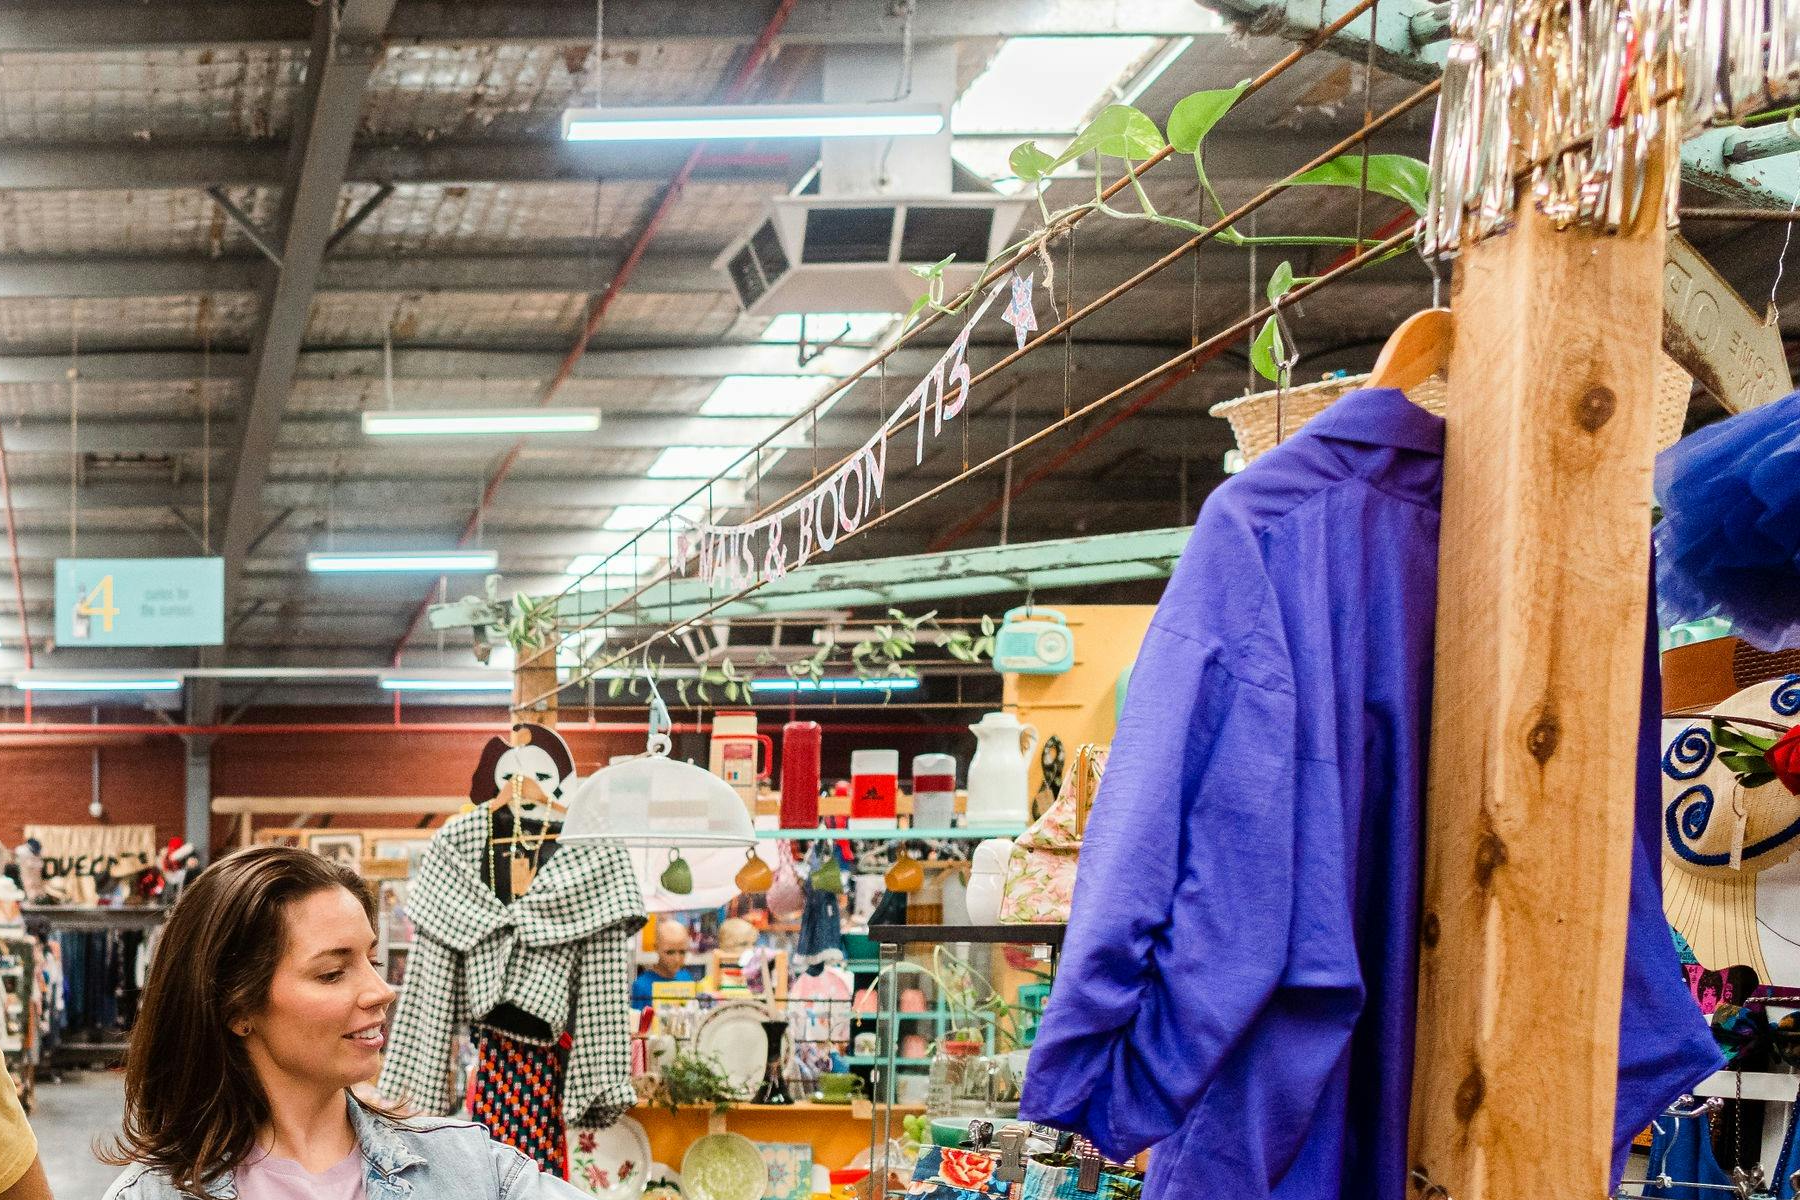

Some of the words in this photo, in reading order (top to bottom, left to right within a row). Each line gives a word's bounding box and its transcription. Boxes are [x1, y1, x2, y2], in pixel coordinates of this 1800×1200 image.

[763, 515, 788, 582] &
[797, 425, 887, 567] BOON
[80, 574, 121, 633] 4
